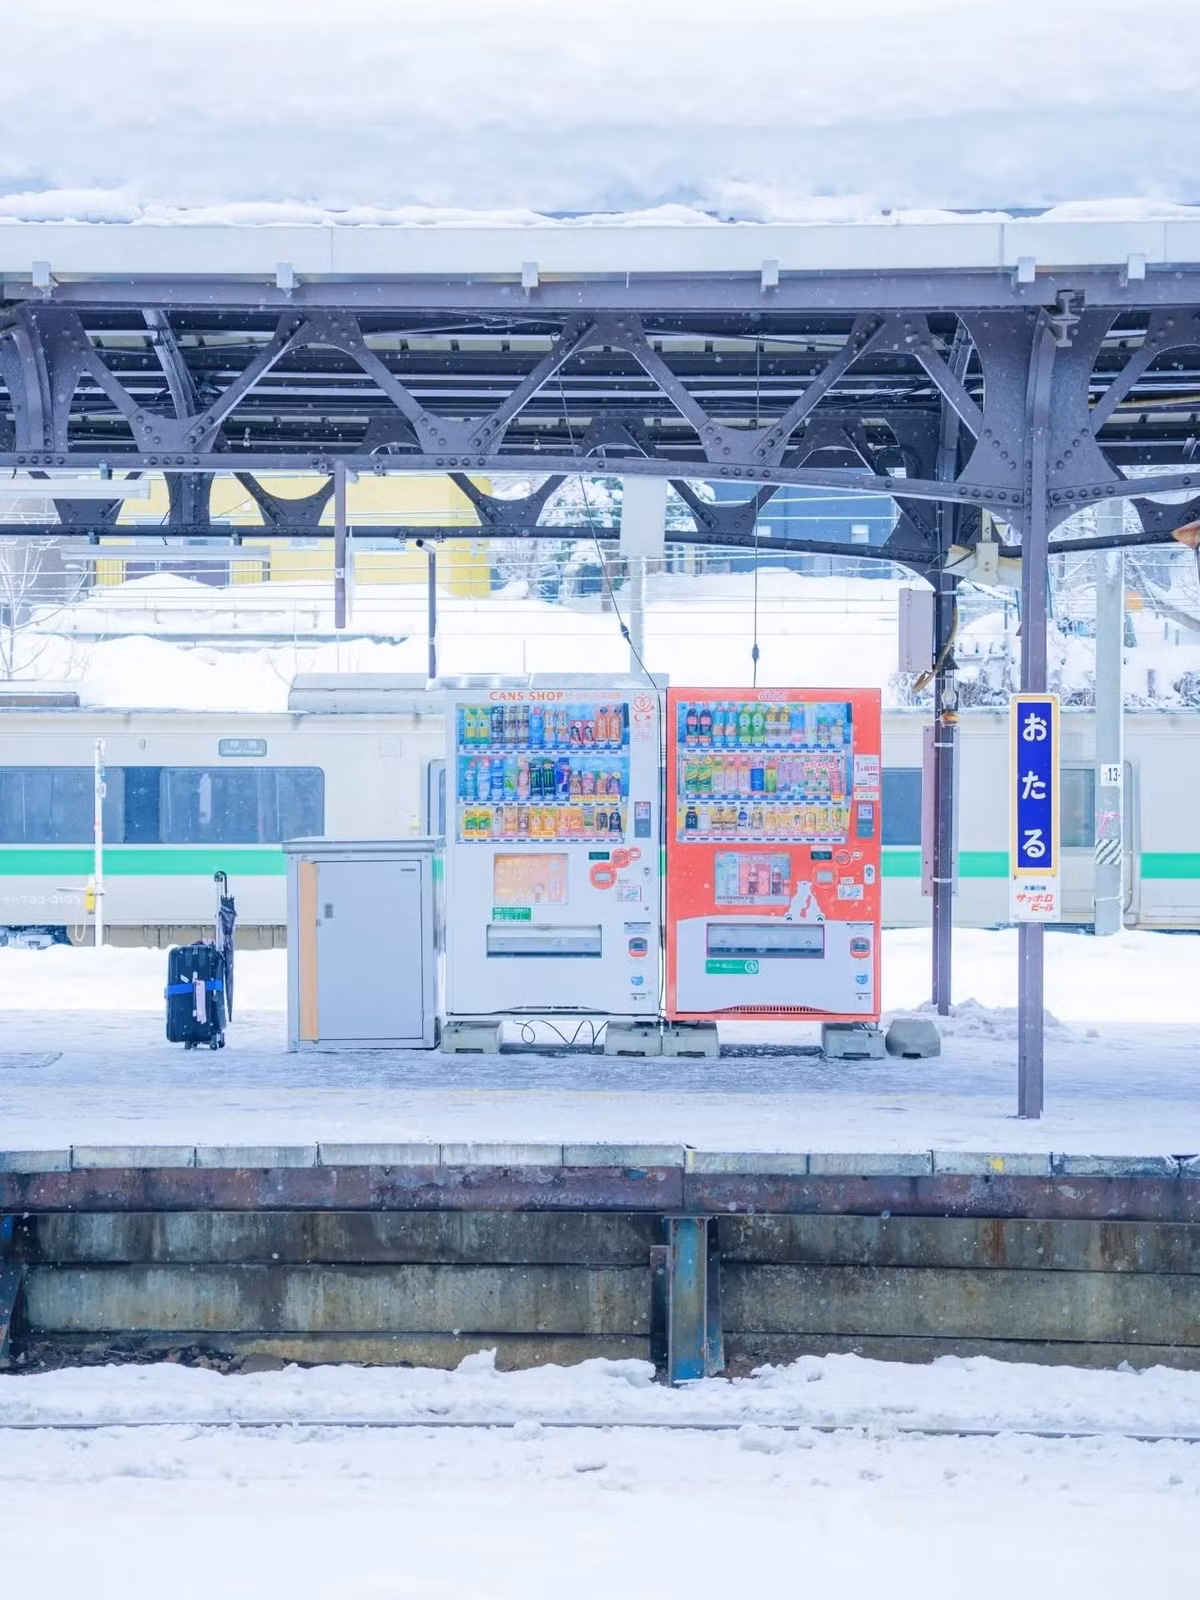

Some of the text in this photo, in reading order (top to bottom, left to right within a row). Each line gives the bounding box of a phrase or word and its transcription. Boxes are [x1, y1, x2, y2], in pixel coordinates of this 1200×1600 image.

[489, 691, 524, 701] CANS
[529, 691, 564, 701] SHOP
[1023, 713, 1047, 858] おたる
